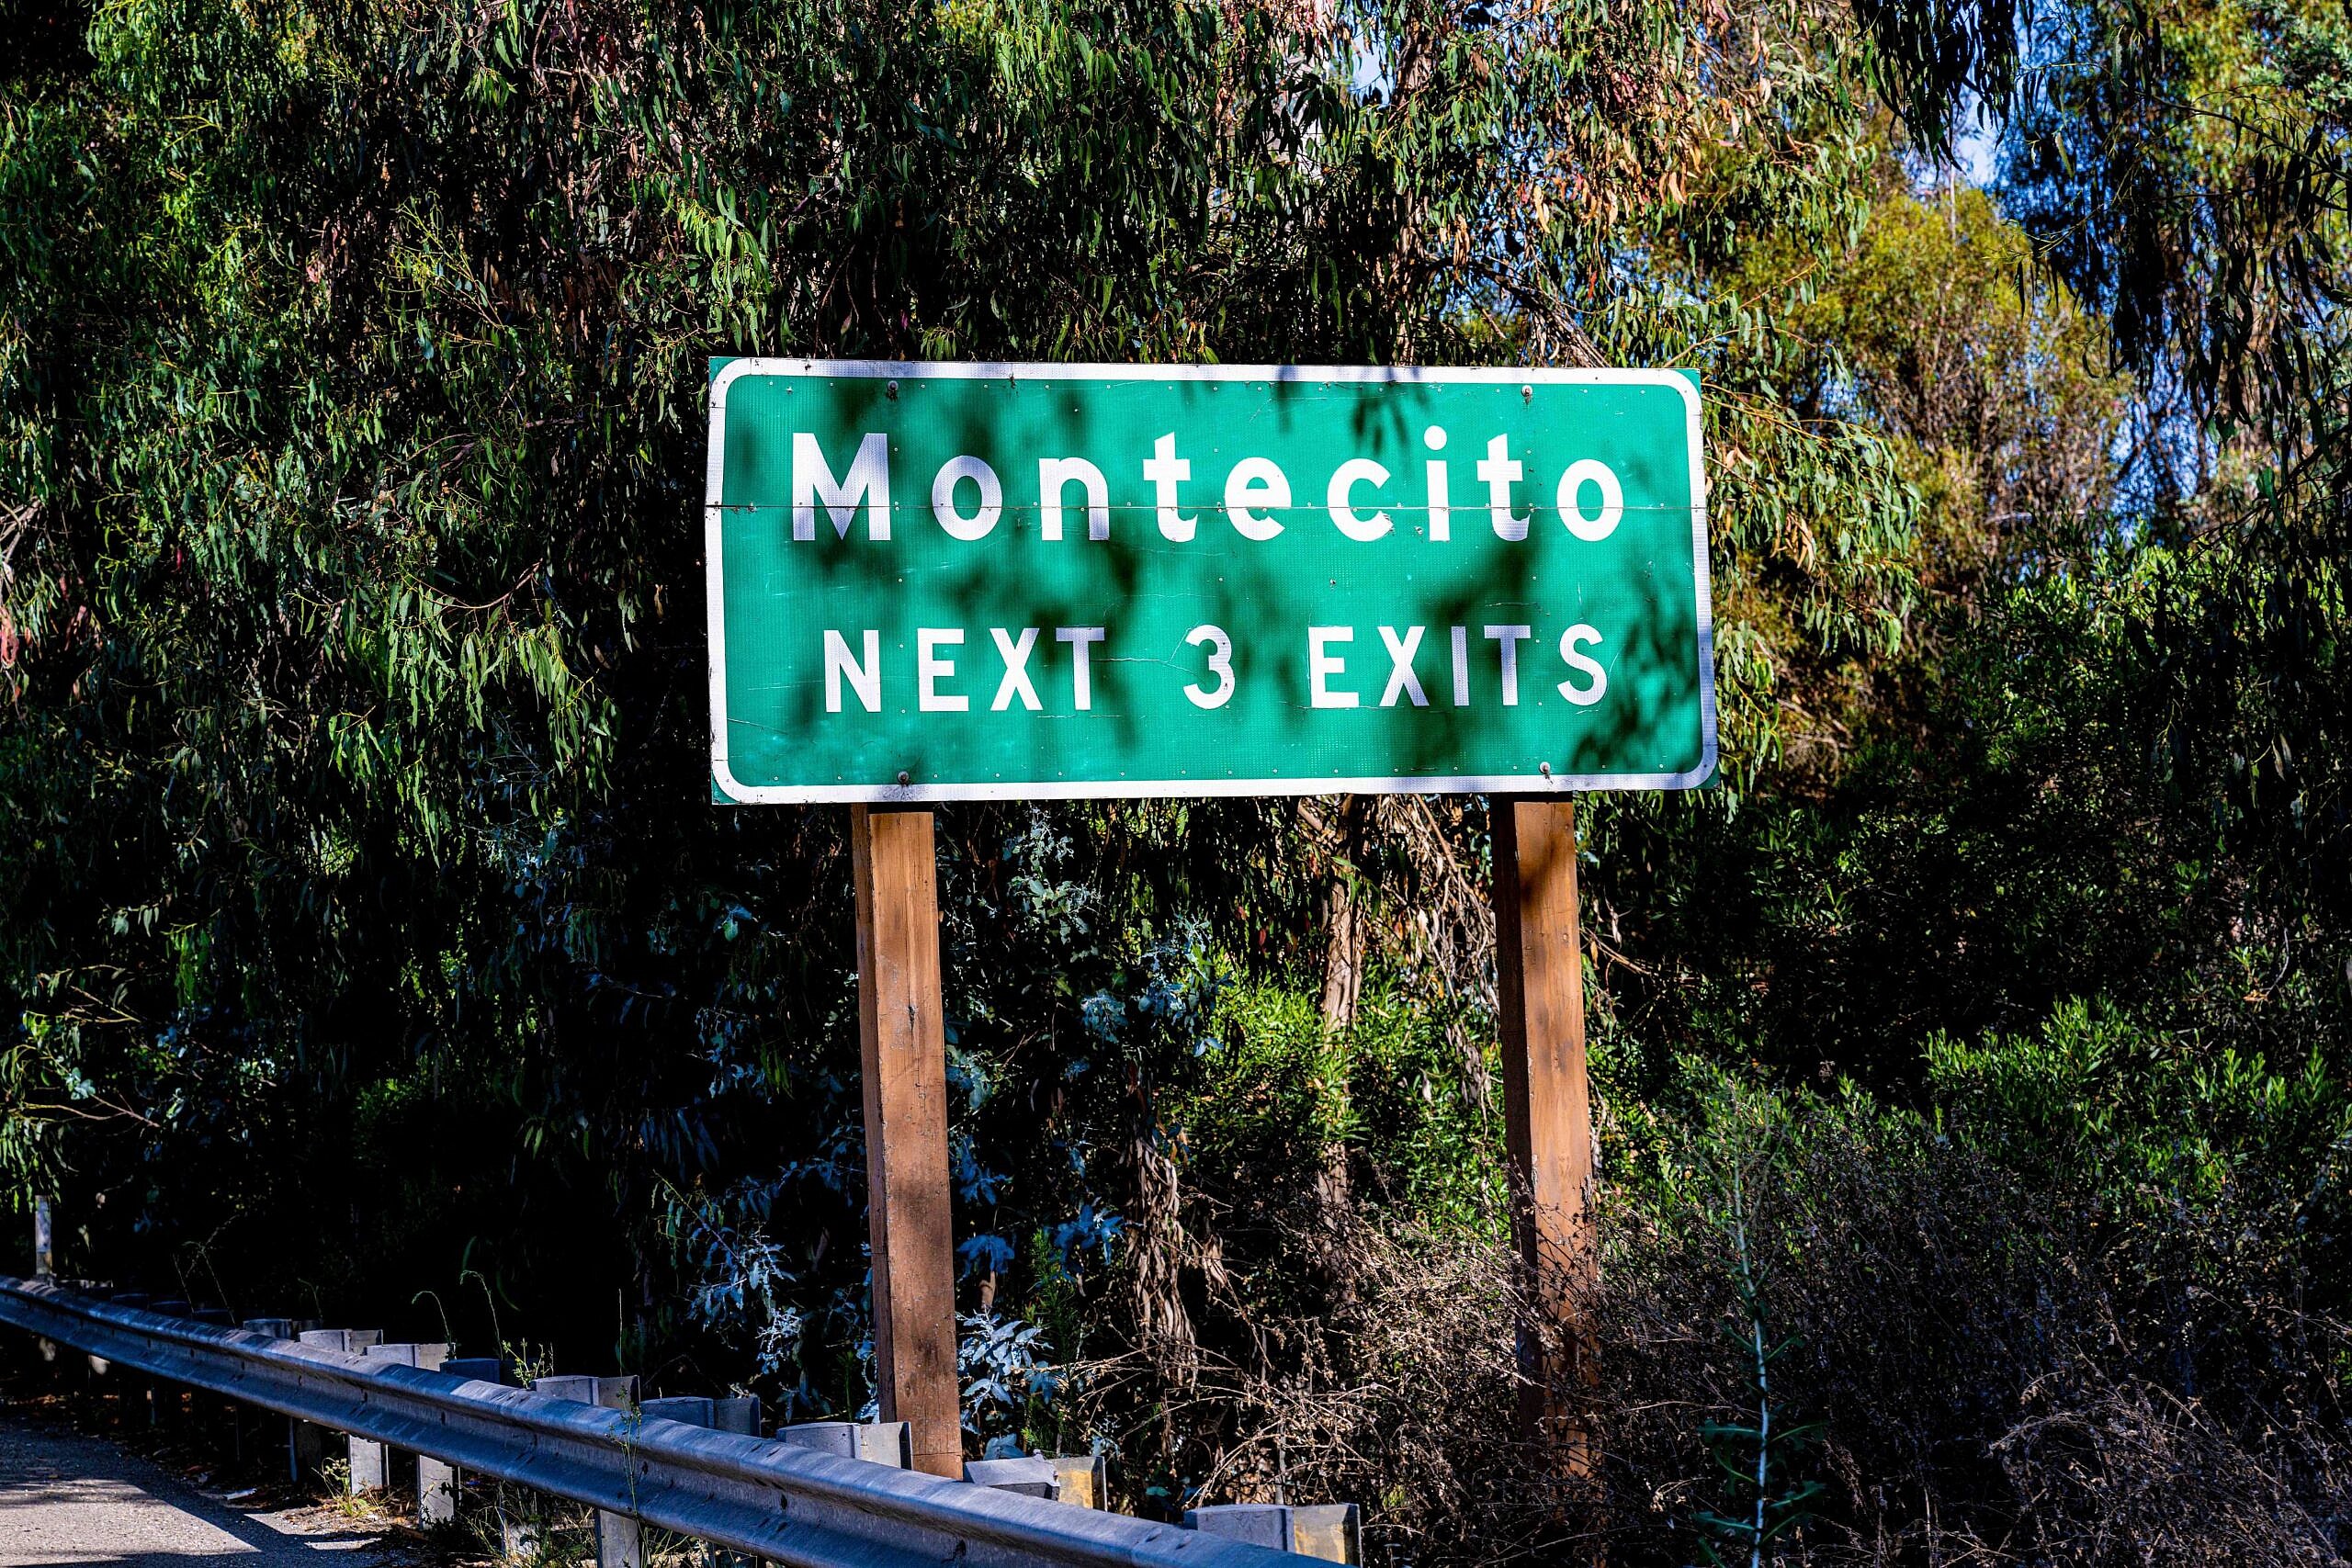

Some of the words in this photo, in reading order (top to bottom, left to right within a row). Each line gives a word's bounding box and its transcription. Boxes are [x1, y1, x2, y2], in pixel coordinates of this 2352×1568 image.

[792, 426, 1623, 542] Montecito
[824, 627, 1105, 713] NEXT
[1183, 625, 1236, 710] 3
[1308, 624, 1608, 708] EXITS
